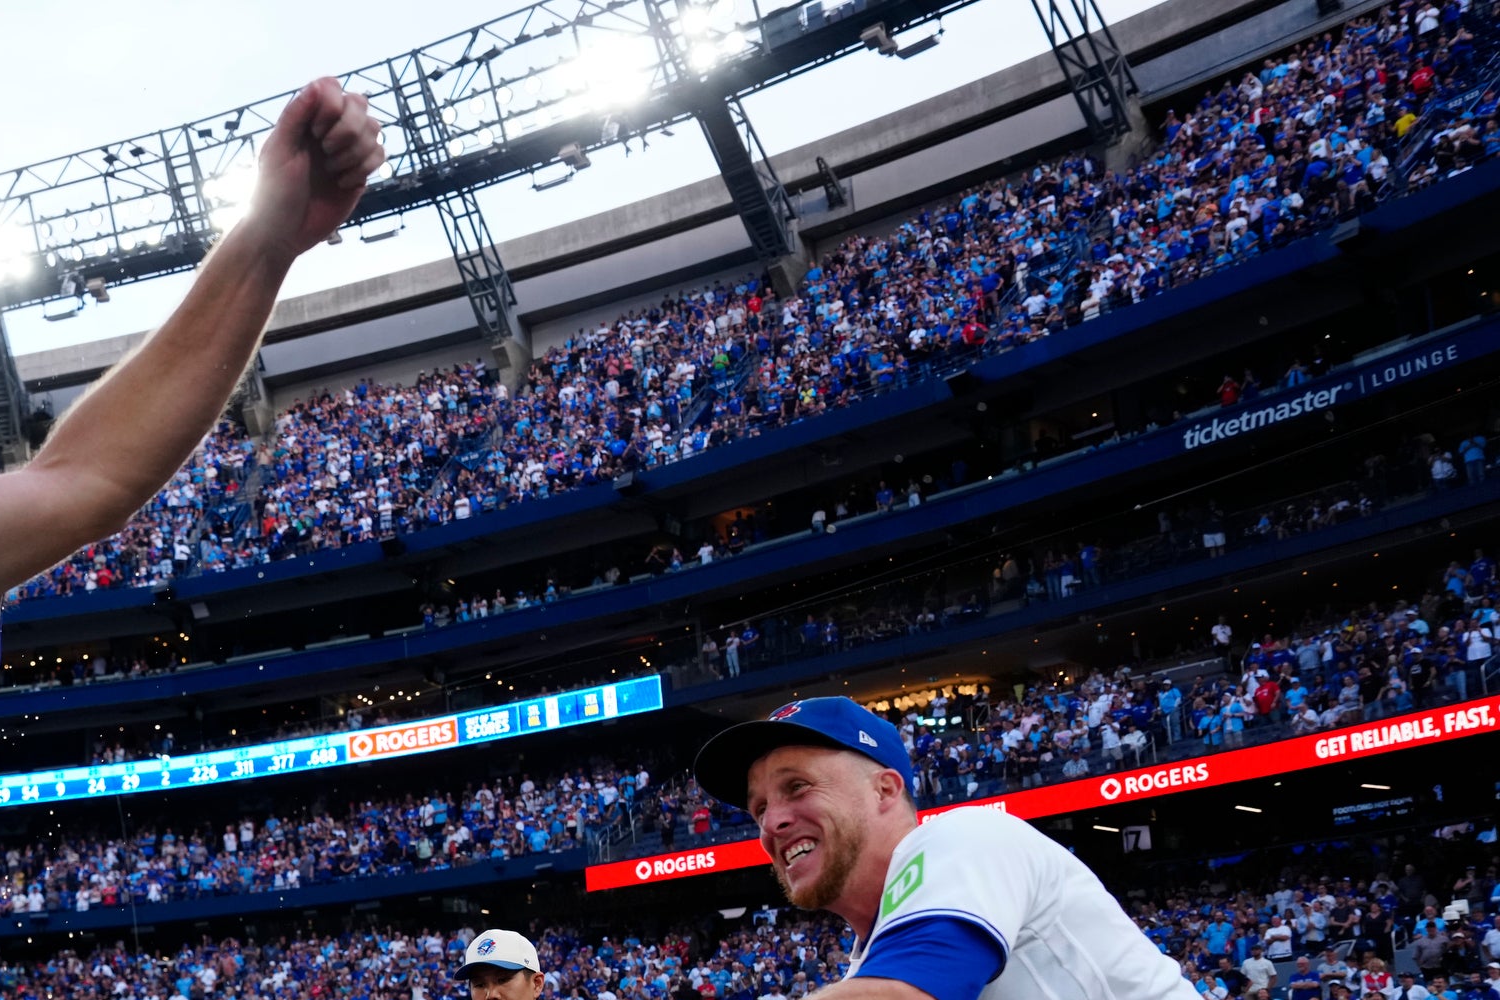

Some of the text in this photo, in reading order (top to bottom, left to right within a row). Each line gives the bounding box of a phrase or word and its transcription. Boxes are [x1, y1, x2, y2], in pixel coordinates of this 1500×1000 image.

[1184, 345, 1458, 450] ticketmaster LOUNGE
[375, 719, 453, 753] ROGERS
[466, 720, 510, 739] SCORES
[1315, 705, 1496, 759] GET RELIABLE, FAST,
[21, 785, 39, 801] 54
[55, 782, 66, 797] 9
[88, 778, 106, 794] 24
[122, 774, 140, 791] 29
[161, 771, 170, 786] 2
[188, 764, 218, 783] .226
[231, 759, 254, 778] .311
[268, 753, 295, 772] .377
[1124, 763, 1209, 795] ROGERS
[654, 852, 716, 877] ROGERS
[886, 863, 920, 905] TD
